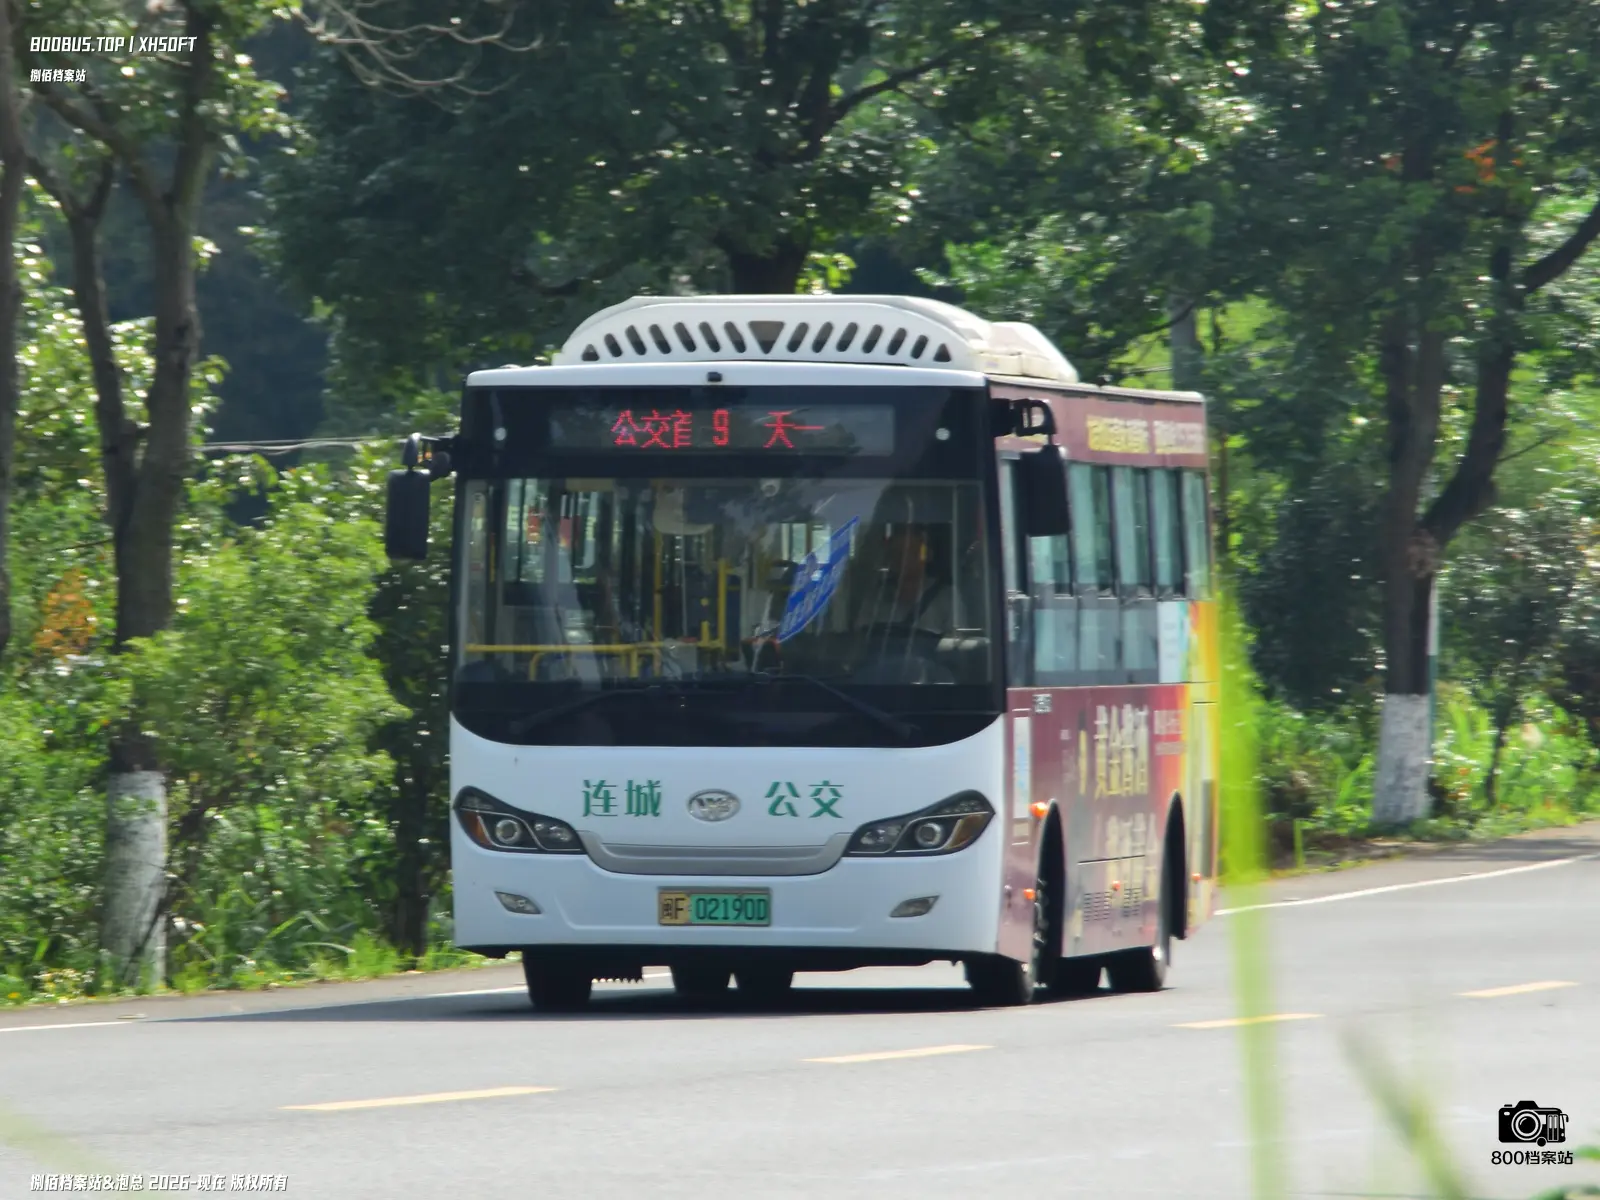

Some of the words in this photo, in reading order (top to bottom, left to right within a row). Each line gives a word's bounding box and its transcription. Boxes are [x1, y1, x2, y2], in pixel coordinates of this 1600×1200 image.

[711, 407, 730, 447] 9
[581, 779, 663, 818] 连城
[764, 780, 845, 819] 公交
